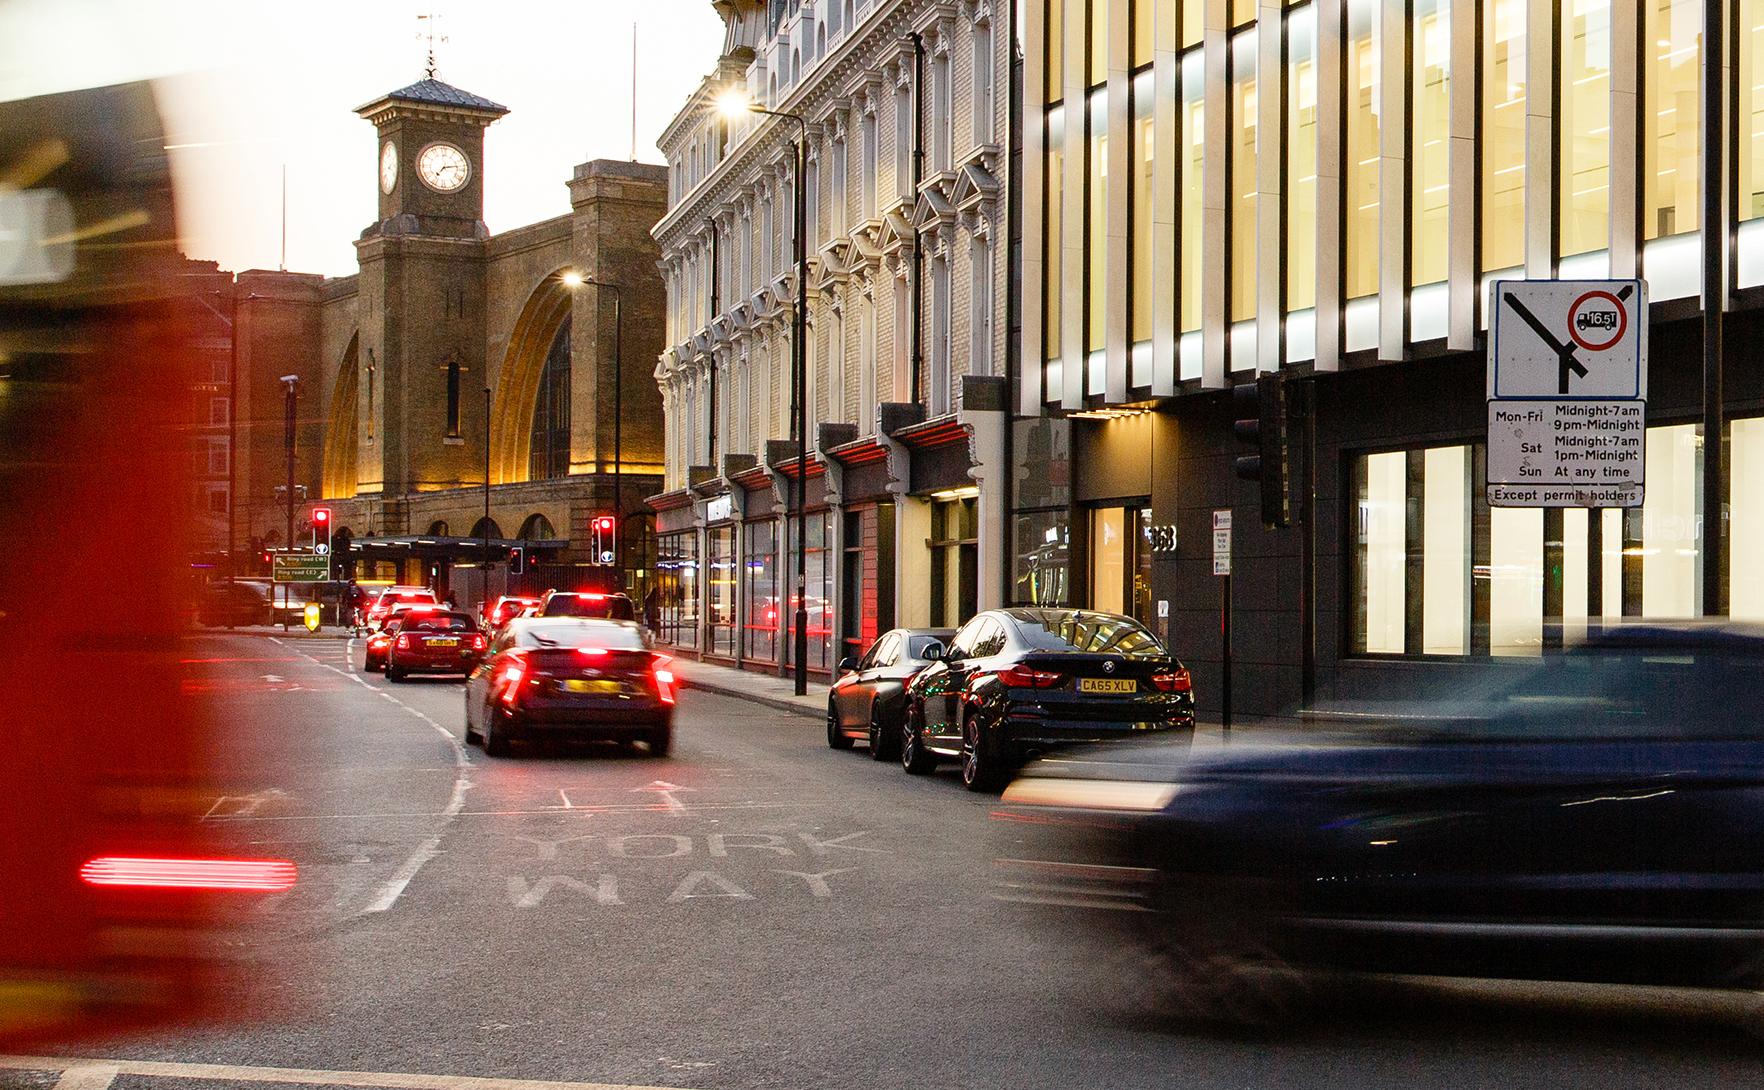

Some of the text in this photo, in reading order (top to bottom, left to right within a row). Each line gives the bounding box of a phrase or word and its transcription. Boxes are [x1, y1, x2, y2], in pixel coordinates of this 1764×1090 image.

[1590, 312, 1616, 324] 16.5T
[1495, 411, 1543, 422] Mon-Fri
[1521, 442, 1542, 453] Sat
[1554, 450, 1638, 462] 1pm-Midnight
[1519, 466, 1630, 479] Sun At any time
[1494, 489, 1636, 502] Except permit holders
[1083, 680, 1135, 692] CA65 XLV
[515, 831, 893, 859] YORK
[506, 866, 860, 908] WAY
